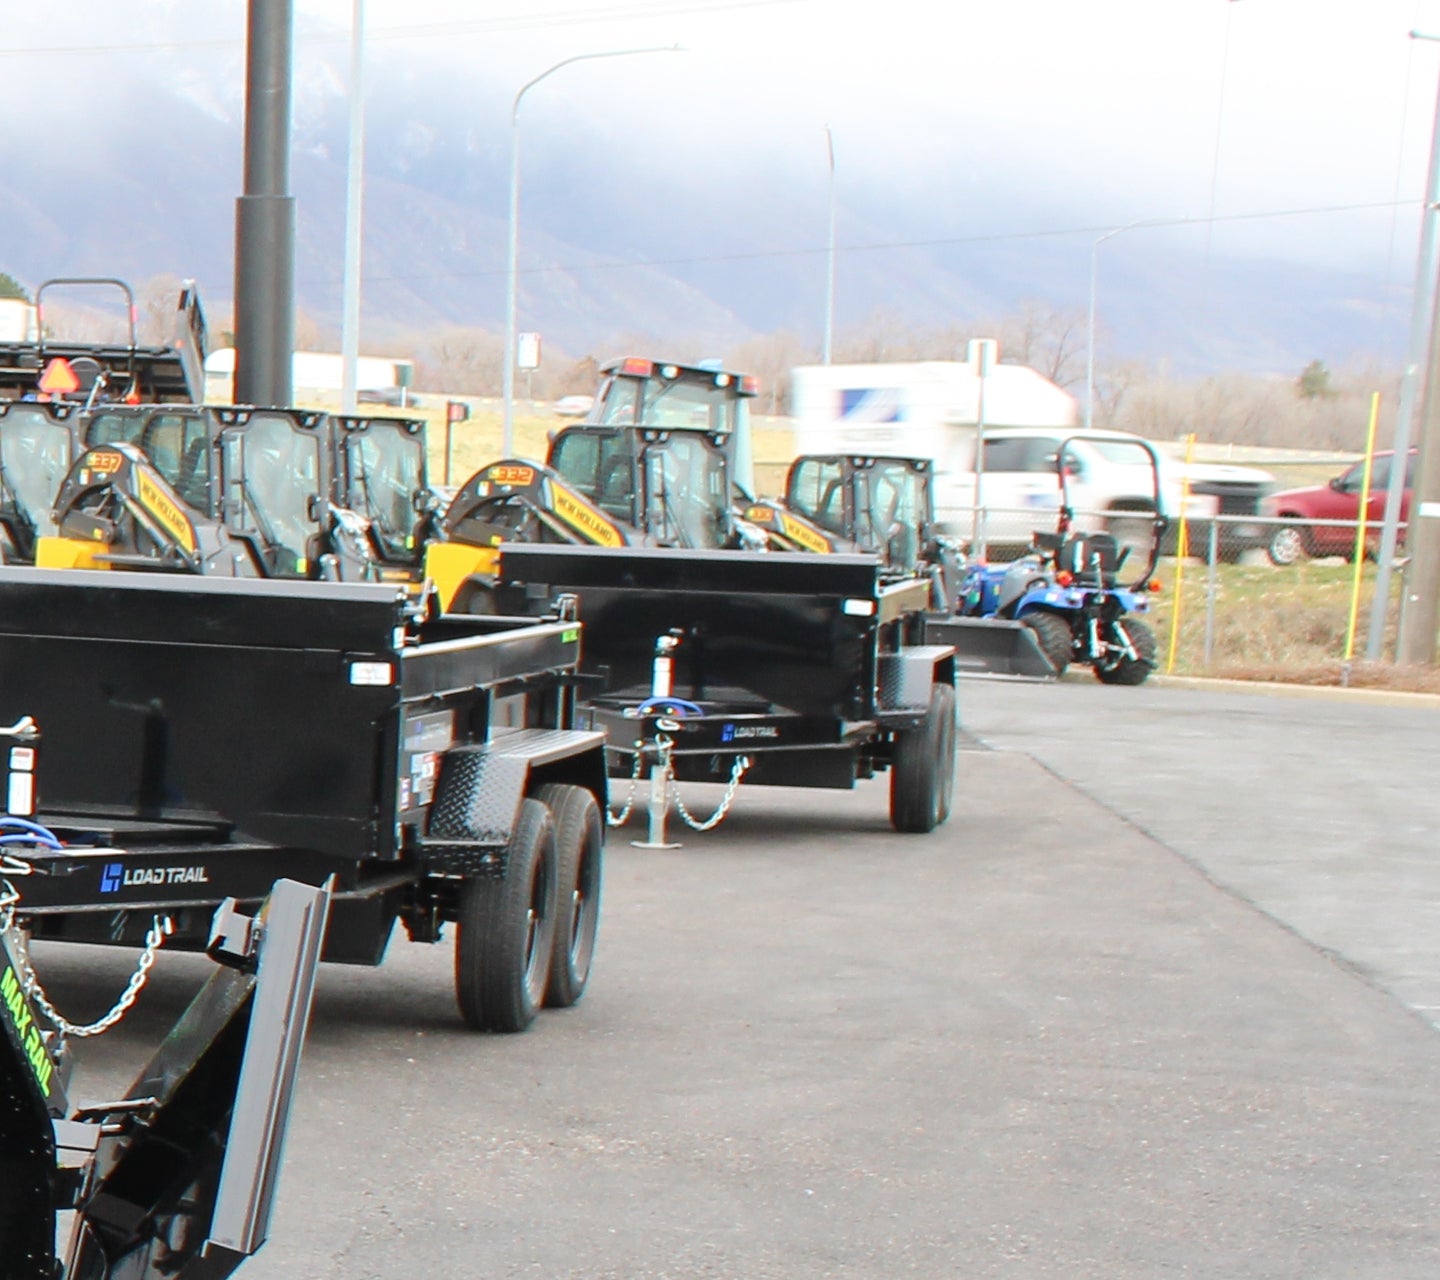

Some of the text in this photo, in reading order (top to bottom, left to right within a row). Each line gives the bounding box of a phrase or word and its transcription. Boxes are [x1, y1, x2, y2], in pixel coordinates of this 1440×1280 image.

[557, 495, 612, 541] NEW HOLLAND
[123, 866, 208, 885] LOAD TRAIL
[0, 965, 53, 1097] MAX RAIL
